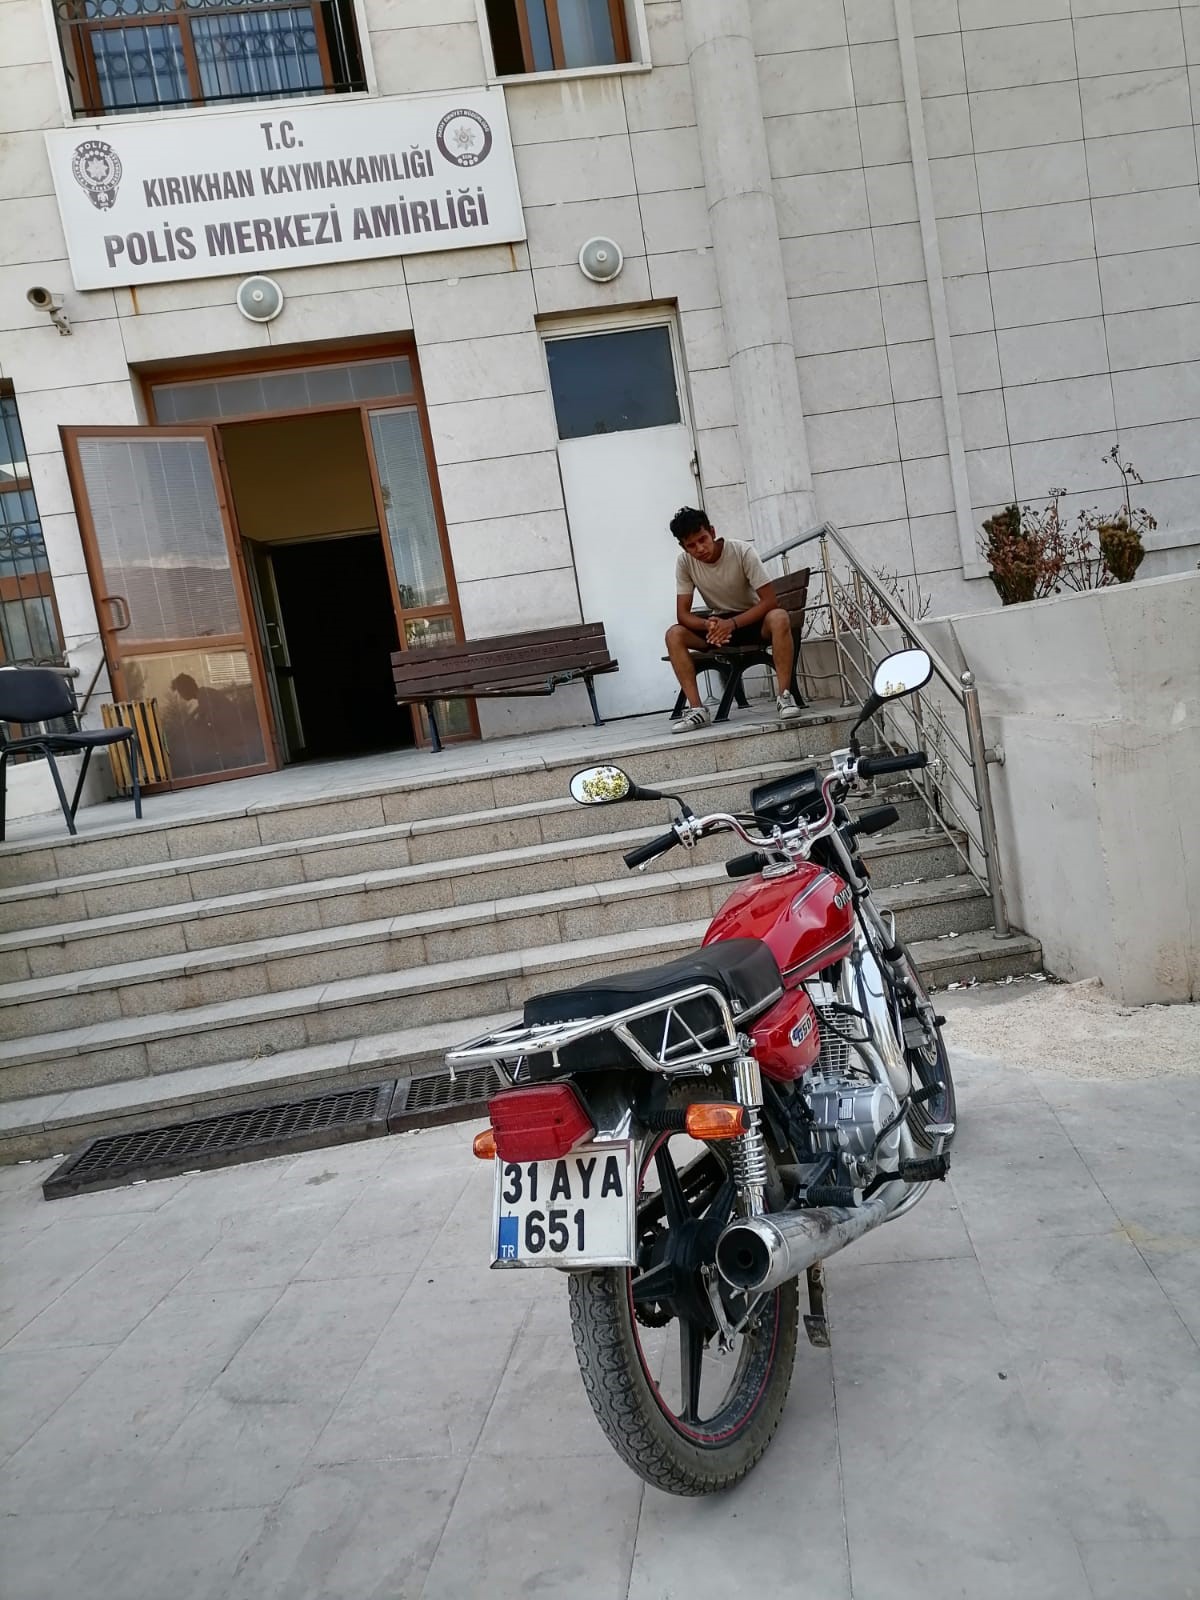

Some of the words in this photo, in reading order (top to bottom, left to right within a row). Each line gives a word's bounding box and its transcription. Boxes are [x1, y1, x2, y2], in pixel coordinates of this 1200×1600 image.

[260, 120, 303, 150] T.C.
[143, 169, 255, 207] KIRIKHAN
[261, 144, 434, 195] KAYMAKAMLIĞI
[104, 221, 197, 268] POLİS
[205, 203, 342, 256] MERKEZİ
[353, 186, 489, 240] AMİRLİĞİ
[503, 1162, 538, 1204] 31
[550, 1155, 623, 1201] AYA
[501, 1245, 515, 1258] TR
[525, 1208, 585, 1253] 651
